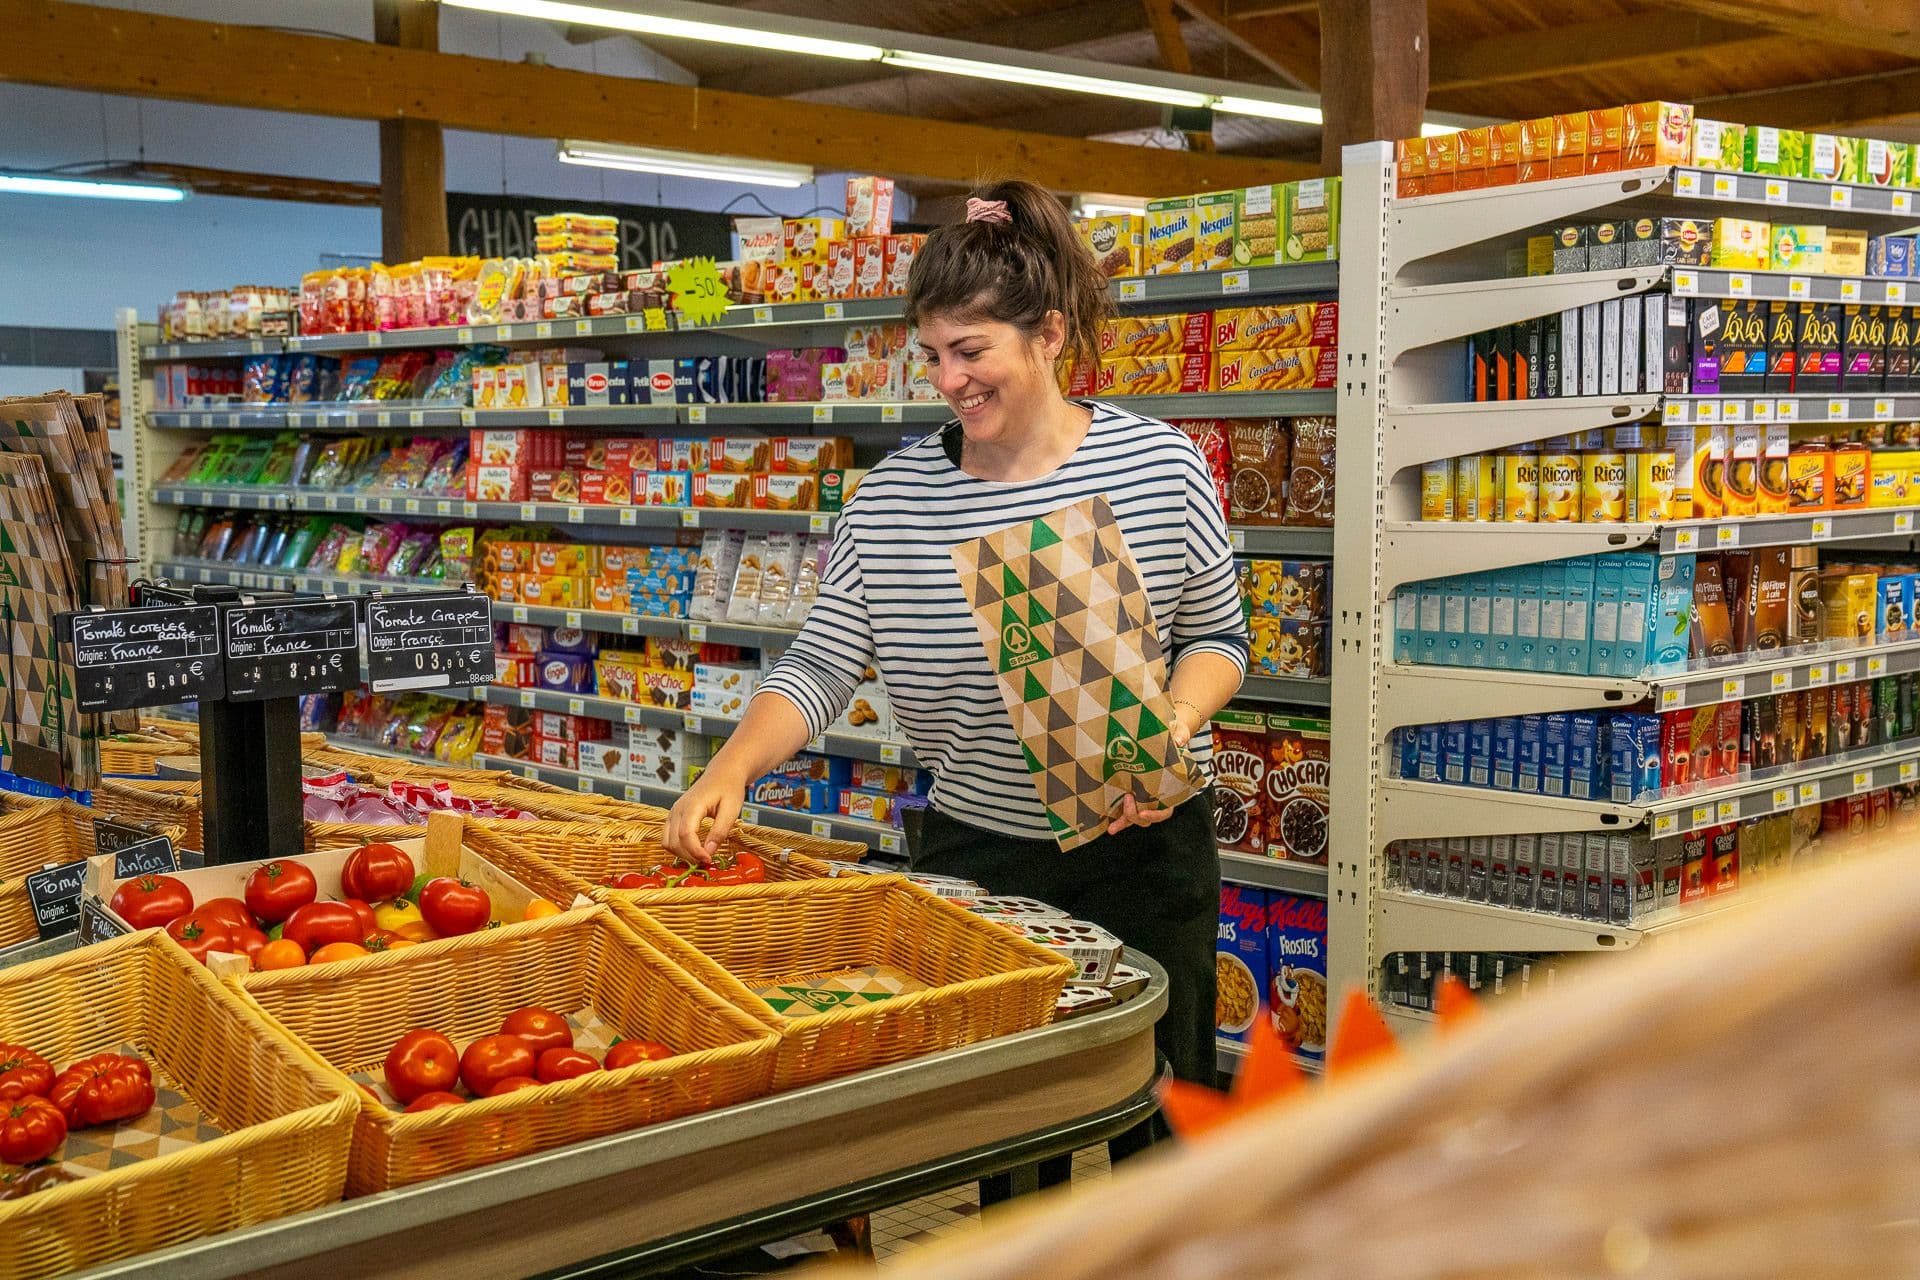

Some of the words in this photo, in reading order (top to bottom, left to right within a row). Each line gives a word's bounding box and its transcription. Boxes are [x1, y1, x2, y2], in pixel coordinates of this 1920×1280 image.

[1150, 216, 1188, 242] Nesquik
[1200, 212, 1232, 236] Nesqui
[1101, 326, 1118, 354] BN
[1217, 316, 1238, 346] BN
[1097, 363, 1116, 392] BN
[1221, 358, 1242, 389] BN
[661, 441, 672, 461] LU
[712, 441, 723, 461] LU
[775, 441, 786, 461] LU
[583, 473, 603, 482] Casino
[1594, 466, 1624, 483] Rico
[636, 477, 645, 495] LU
[695, 476, 704, 495] LU
[756, 477, 766, 497] LU
[1750, 564, 1759, 616] Casino
[1649, 584, 1658, 631] Casino
[232, 614, 275, 635] Tomate
[374, 608, 426, 628] Tomate
[432, 609, 488, 625] Grappe
[110, 642, 162, 660] France
[263, 635, 312, 654] France
[1009, 652, 1038, 666] SPAR
[1113, 762, 1145, 772] SPAR
[755, 783, 794, 802] Granola
[841, 792, 849, 806] LU
[1280, 936, 1318, 958] FROSTIES
